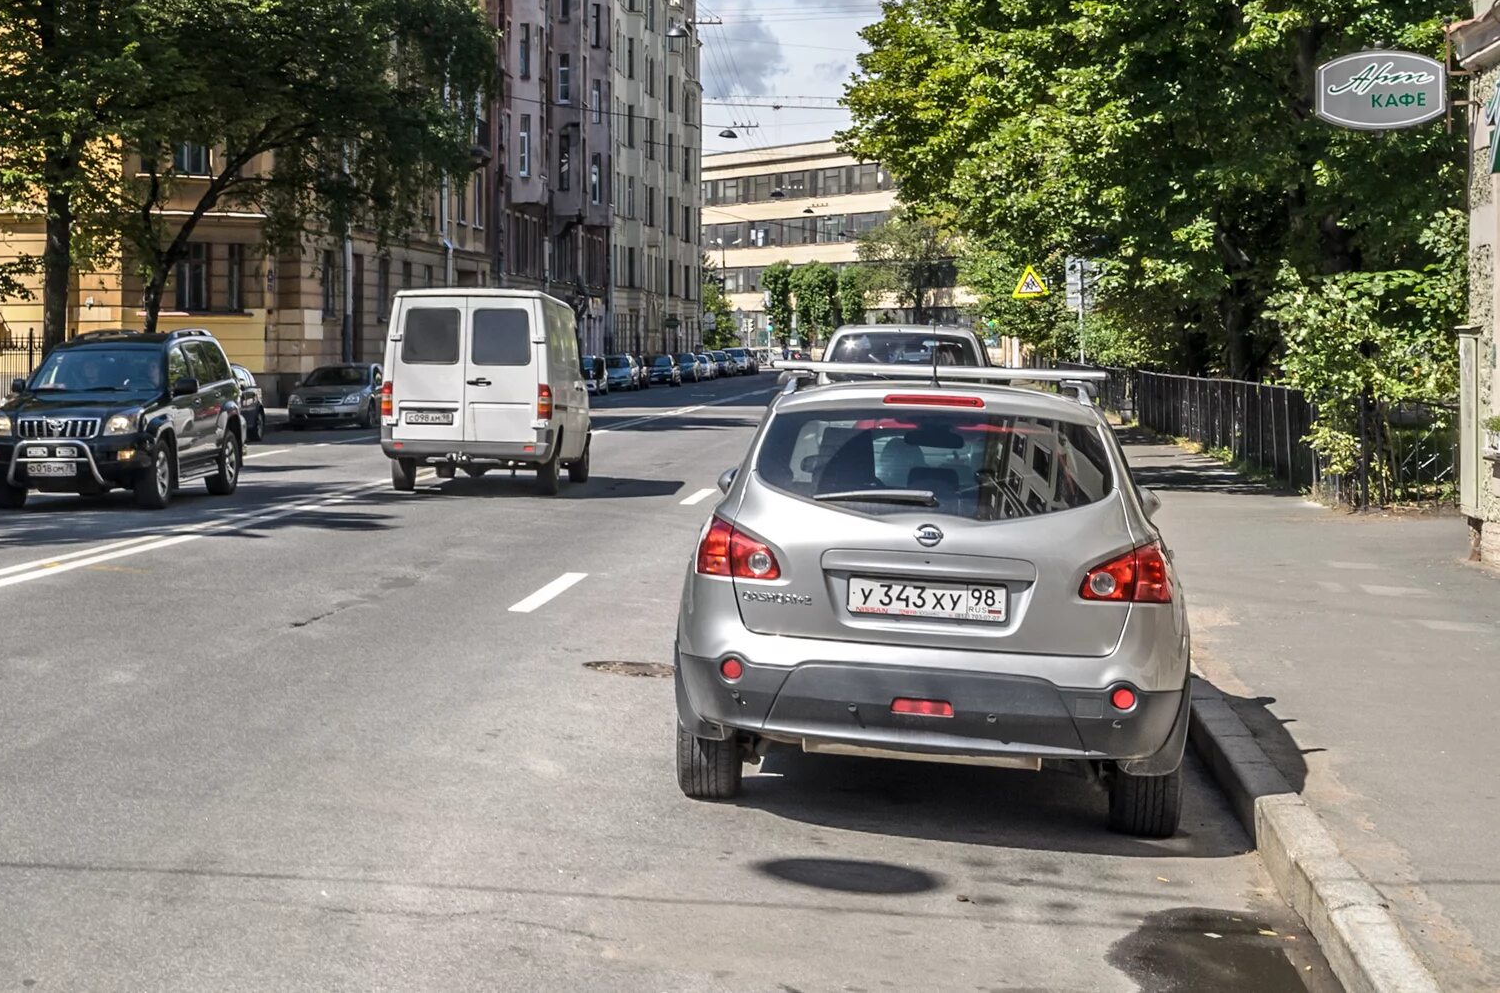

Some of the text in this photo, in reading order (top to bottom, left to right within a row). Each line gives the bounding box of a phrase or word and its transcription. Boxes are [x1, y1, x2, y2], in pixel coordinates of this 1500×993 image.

[1327, 62, 1436, 96] Арт
[1371, 92, 1426, 108] КАФЕ
[971, 588, 996, 607] 98
[855, 606, 889, 614] NISSAN
[968, 605, 987, 614] RUS
